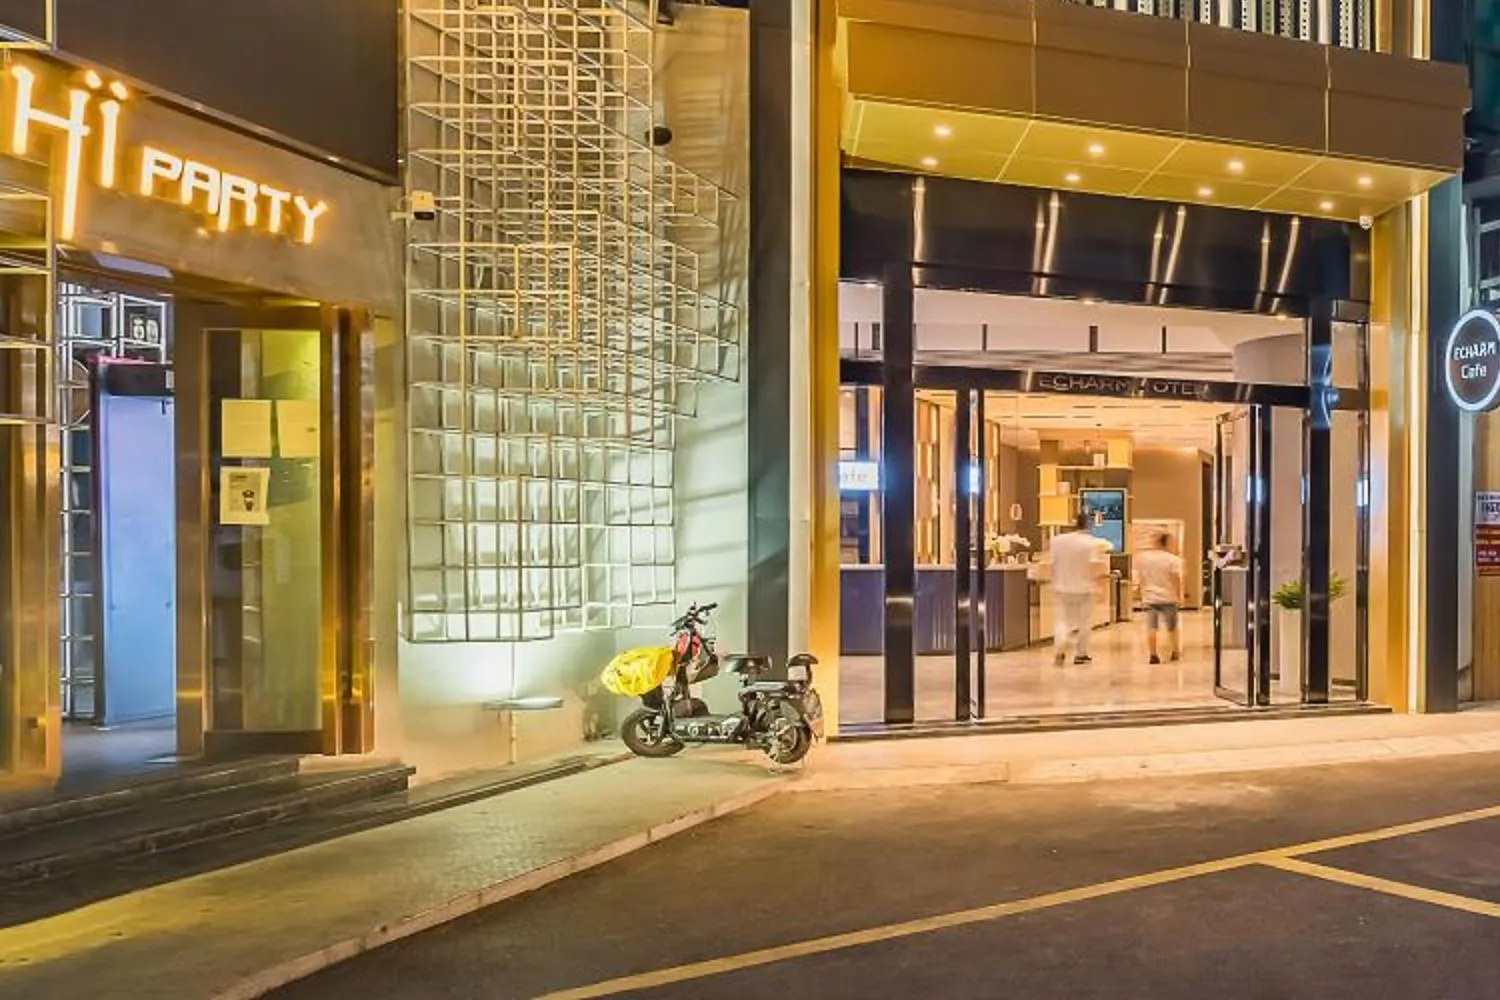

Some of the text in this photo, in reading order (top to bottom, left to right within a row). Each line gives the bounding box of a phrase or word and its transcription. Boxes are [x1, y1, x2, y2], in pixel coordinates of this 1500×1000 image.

[11, 64, 329, 245] Hi PARTY
[1453, 341, 1497, 361] ECHARM
[1461, 362, 1488, 379] Cafe
